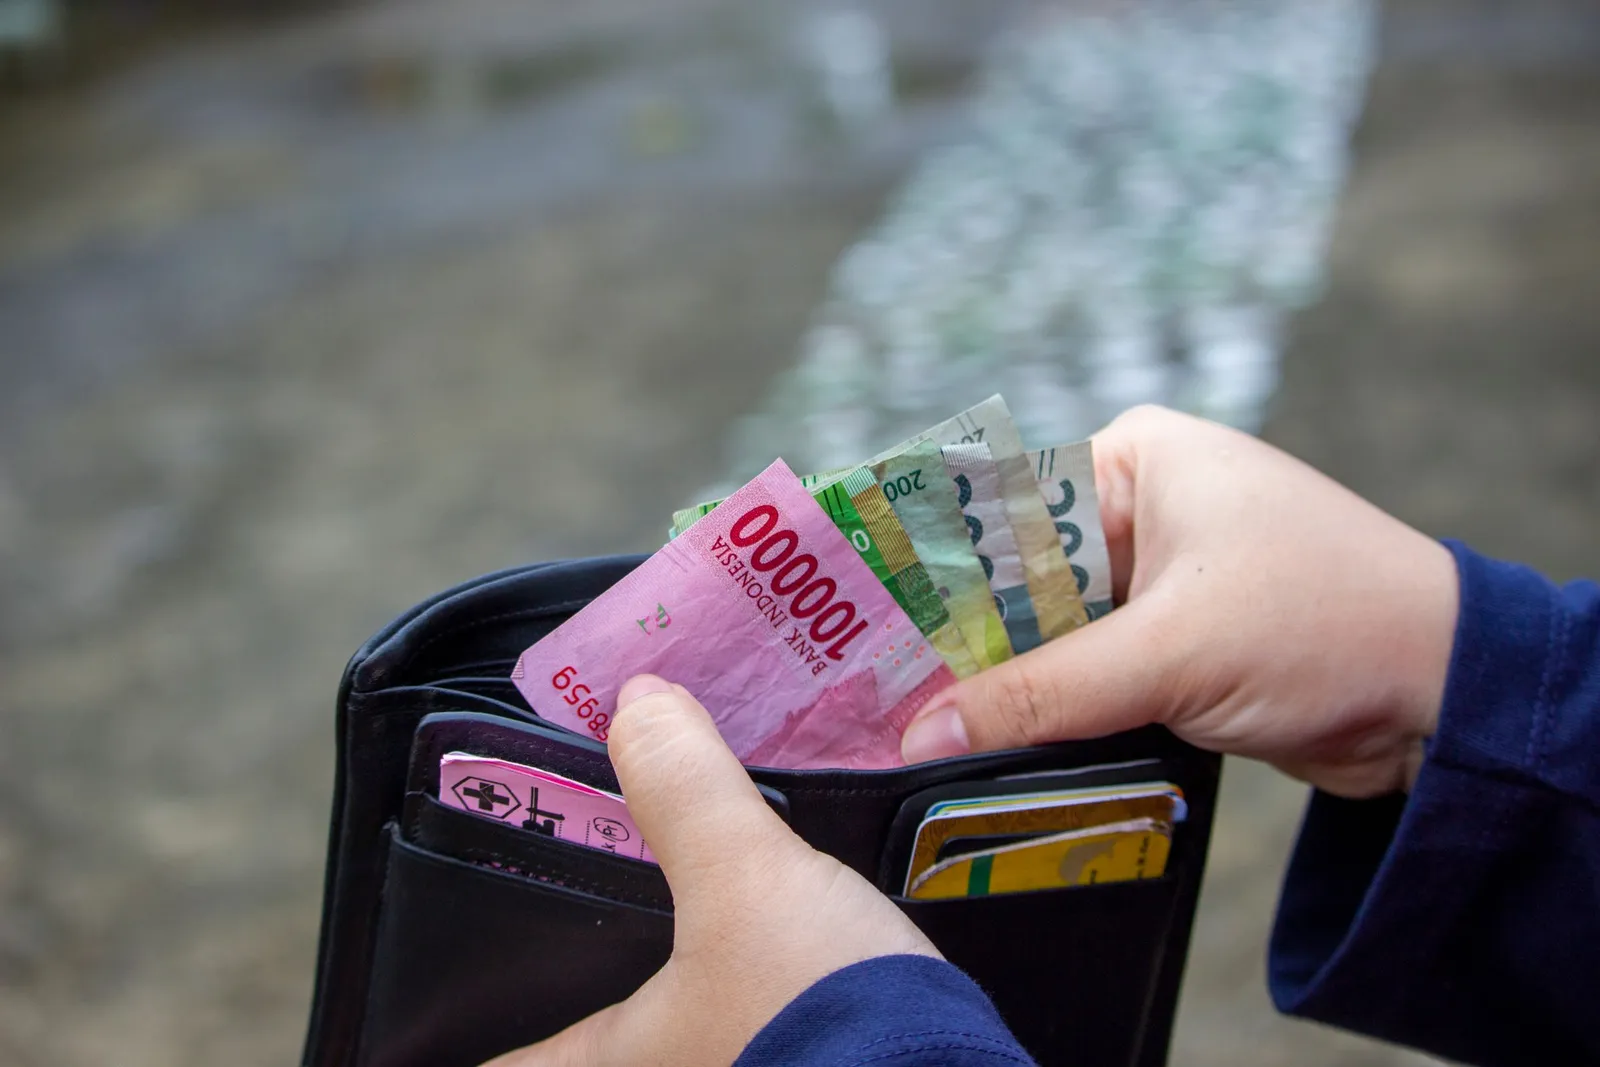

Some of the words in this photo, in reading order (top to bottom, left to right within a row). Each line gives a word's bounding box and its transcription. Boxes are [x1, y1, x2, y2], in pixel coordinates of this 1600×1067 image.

[710, 534, 788, 629] INDONESIA
[729, 504, 869, 662] 100000
[784, 626, 827, 676] BANK
